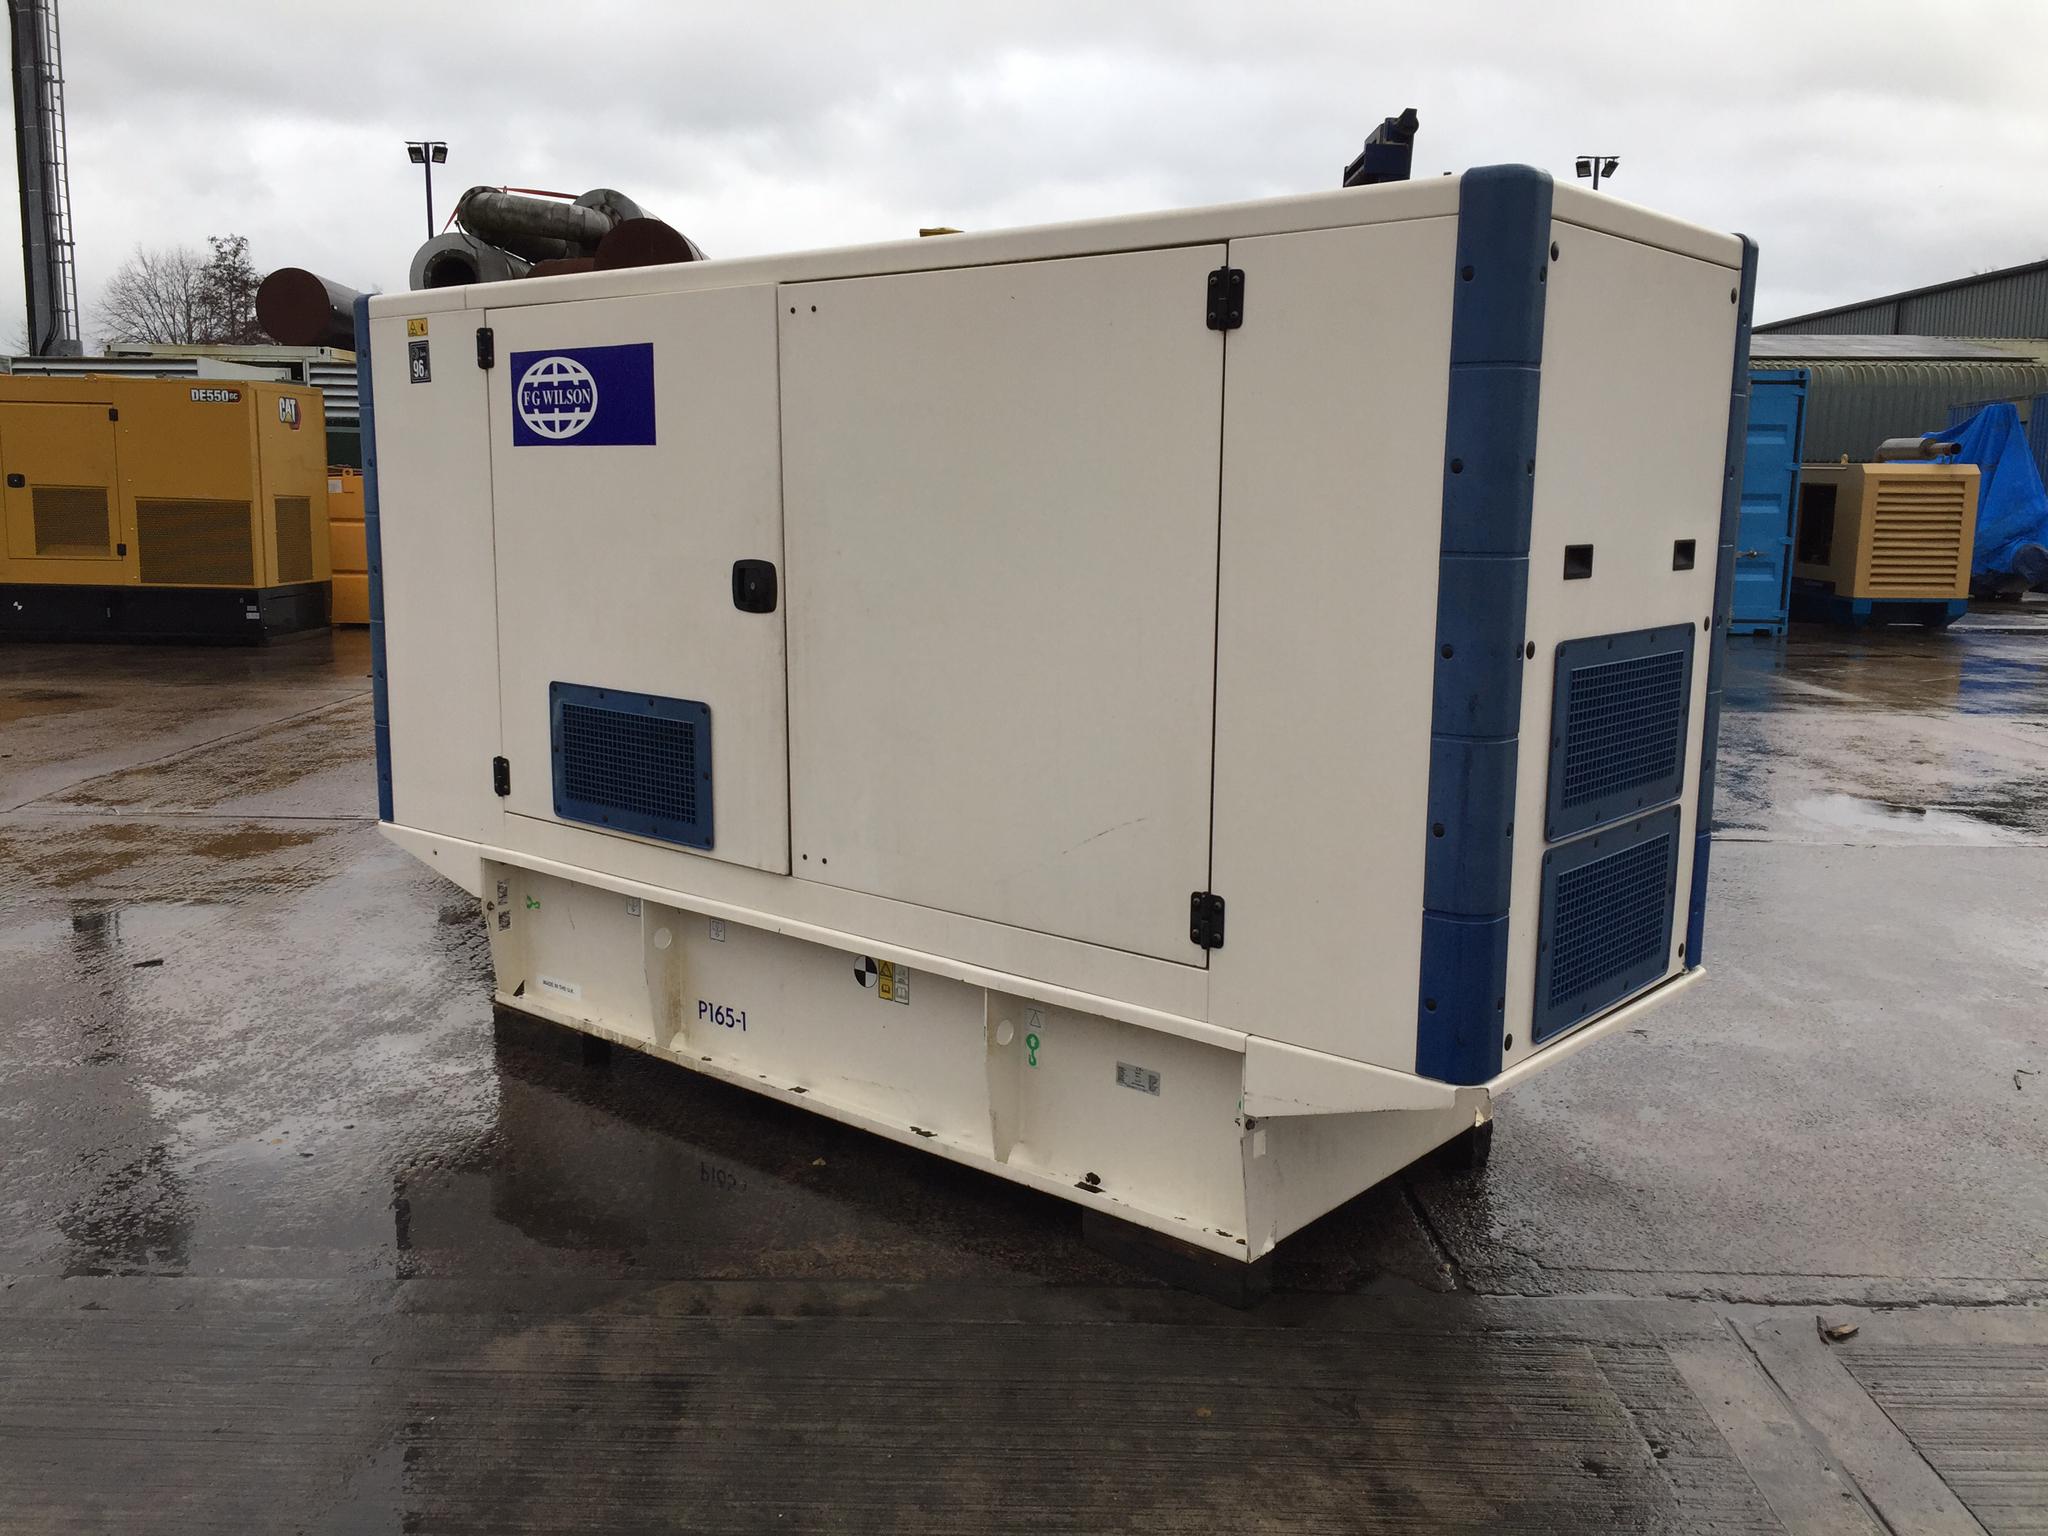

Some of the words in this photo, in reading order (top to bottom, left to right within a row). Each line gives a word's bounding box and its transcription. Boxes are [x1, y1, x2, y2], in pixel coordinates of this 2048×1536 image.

[413, 360, 425, 377] 96
[191, 389, 229, 402] DE550
[523, 390, 540, 406] FG
[542, 388, 591, 405] WILSON
[279, 398, 296, 422] CAT
[698, 1000, 746, 1031] P165-1
